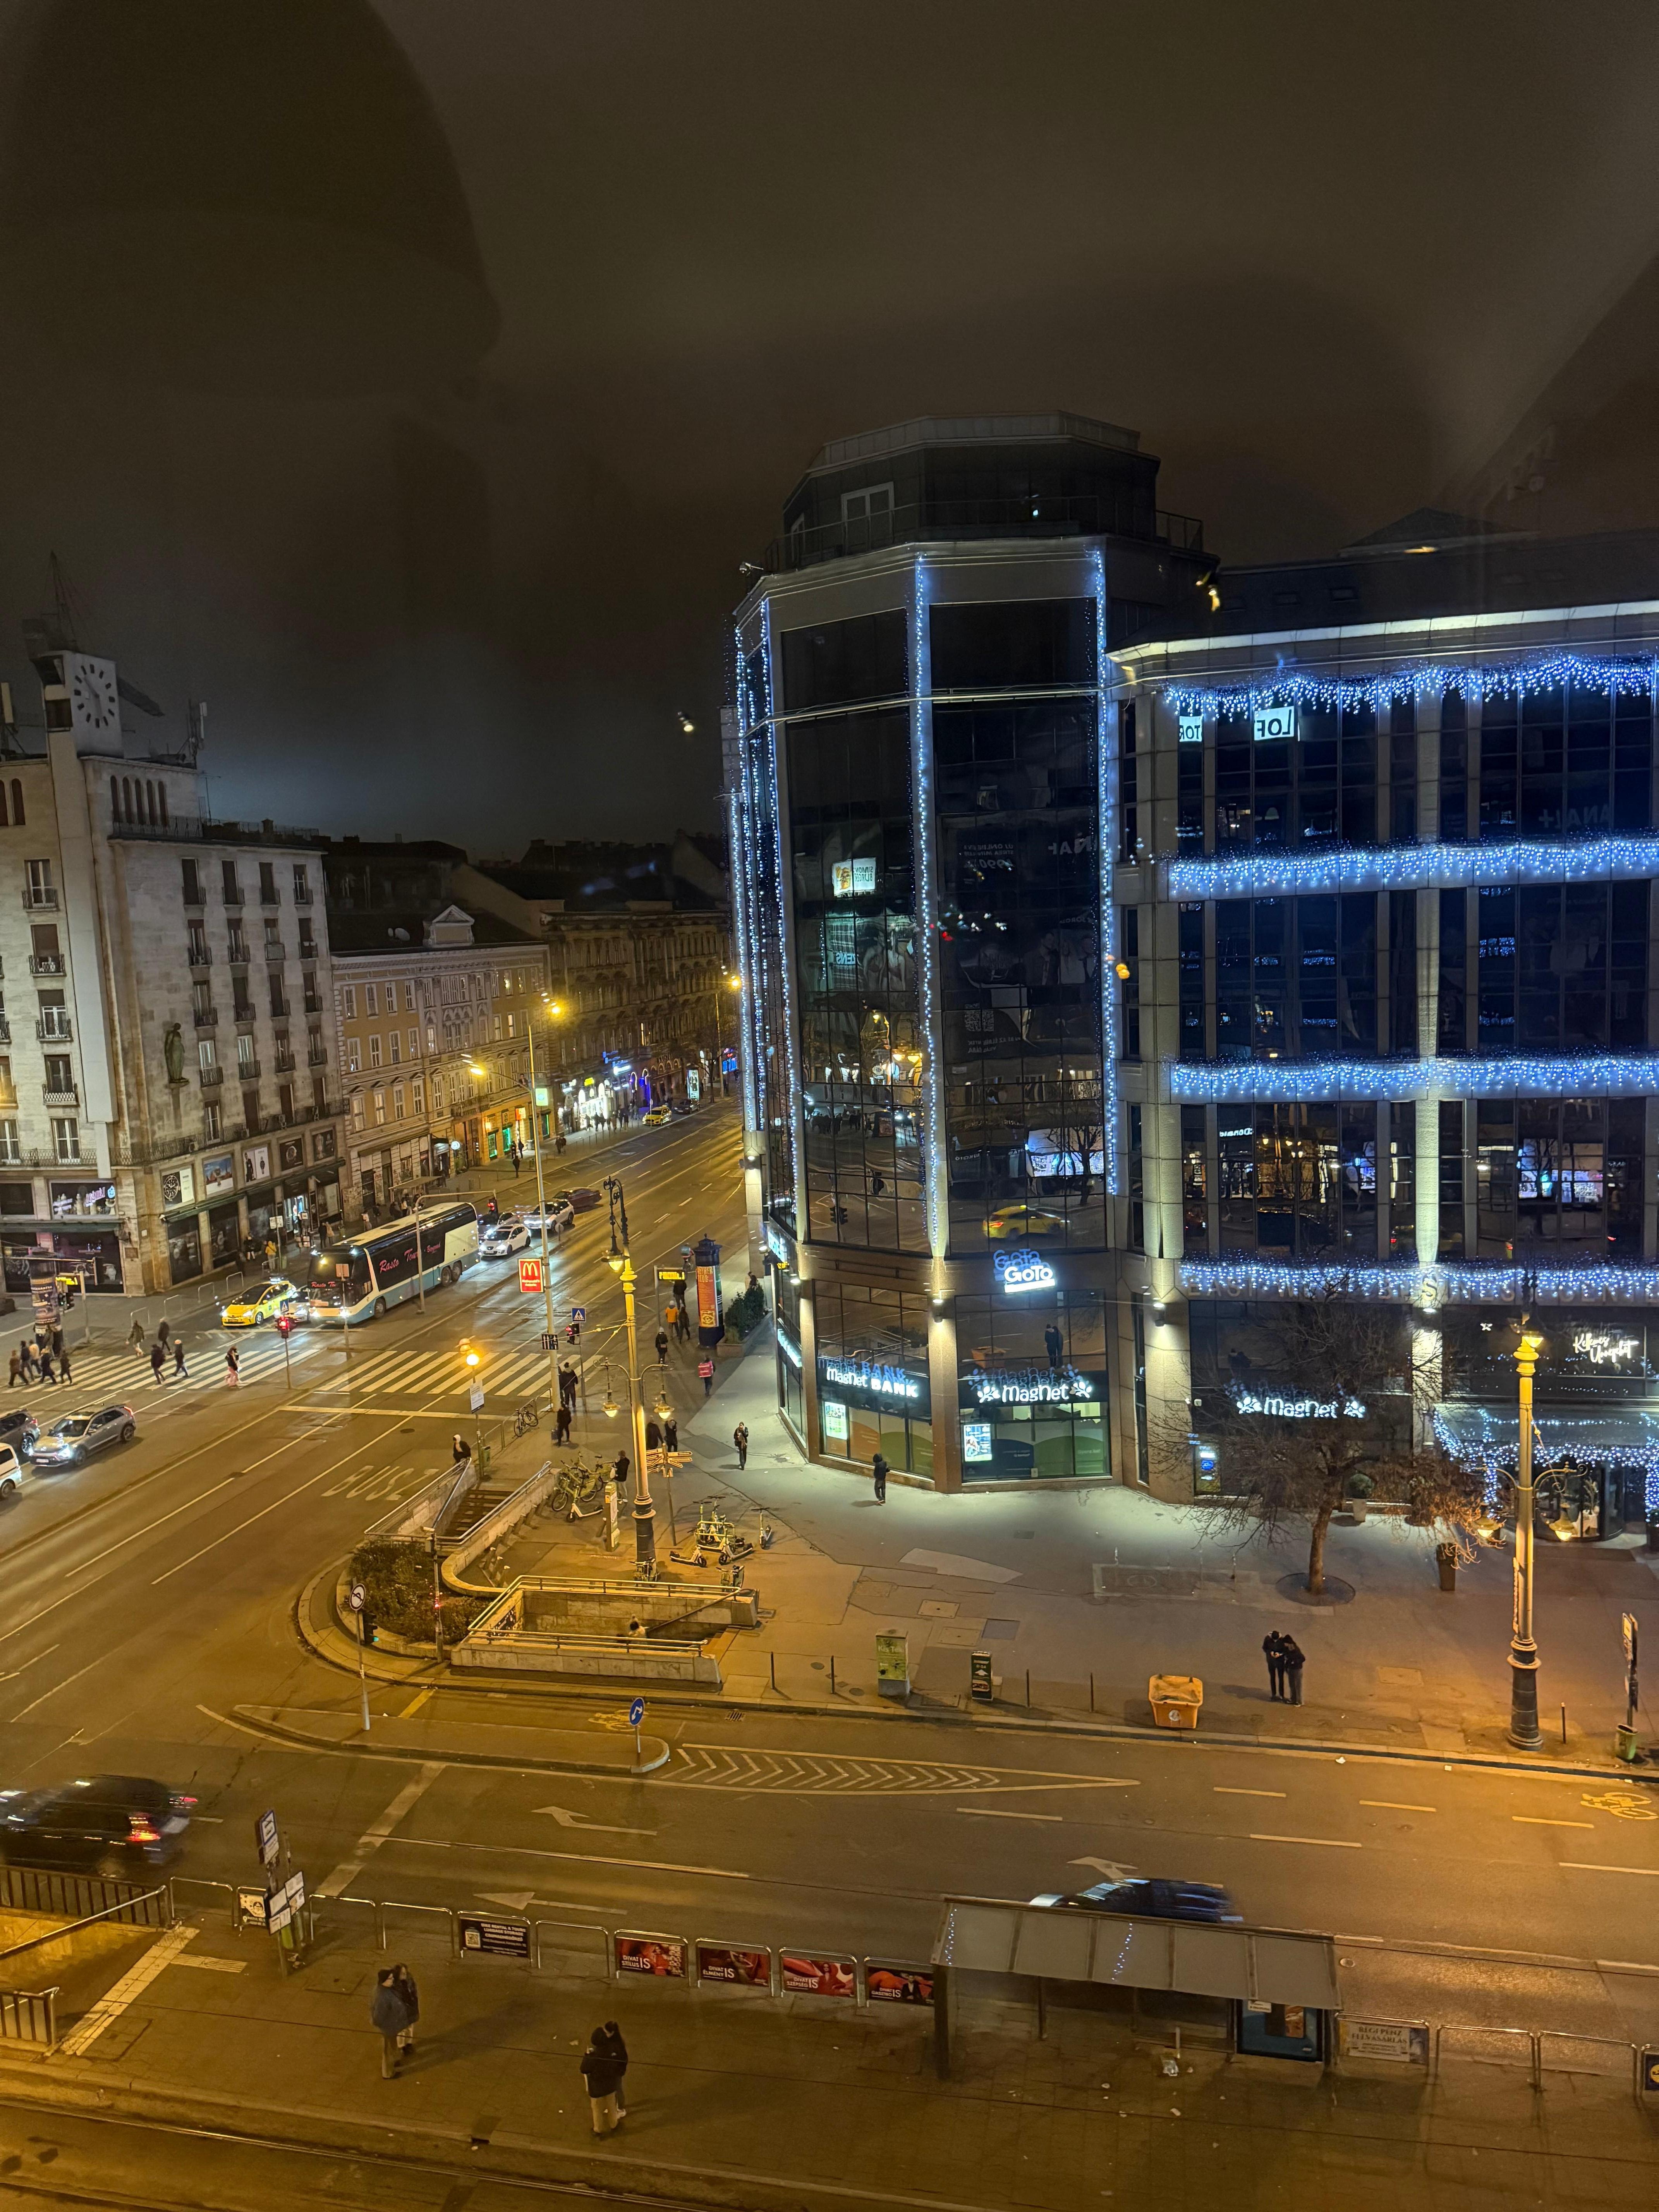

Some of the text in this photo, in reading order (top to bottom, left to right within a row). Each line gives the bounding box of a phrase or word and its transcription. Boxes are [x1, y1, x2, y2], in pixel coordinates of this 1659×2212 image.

[379, 1258, 400, 1273] Rasto
[1004, 1265, 1053, 1283] GoTo
[871, 1378, 918, 1398] BANK
[321, 1465, 440, 1501] BUSZ
[640, 1958, 651, 1969] IS
[724, 1968, 735, 1978] IS
[809, 1979, 819, 1989] IS
[893, 1989, 902, 1998] IS
